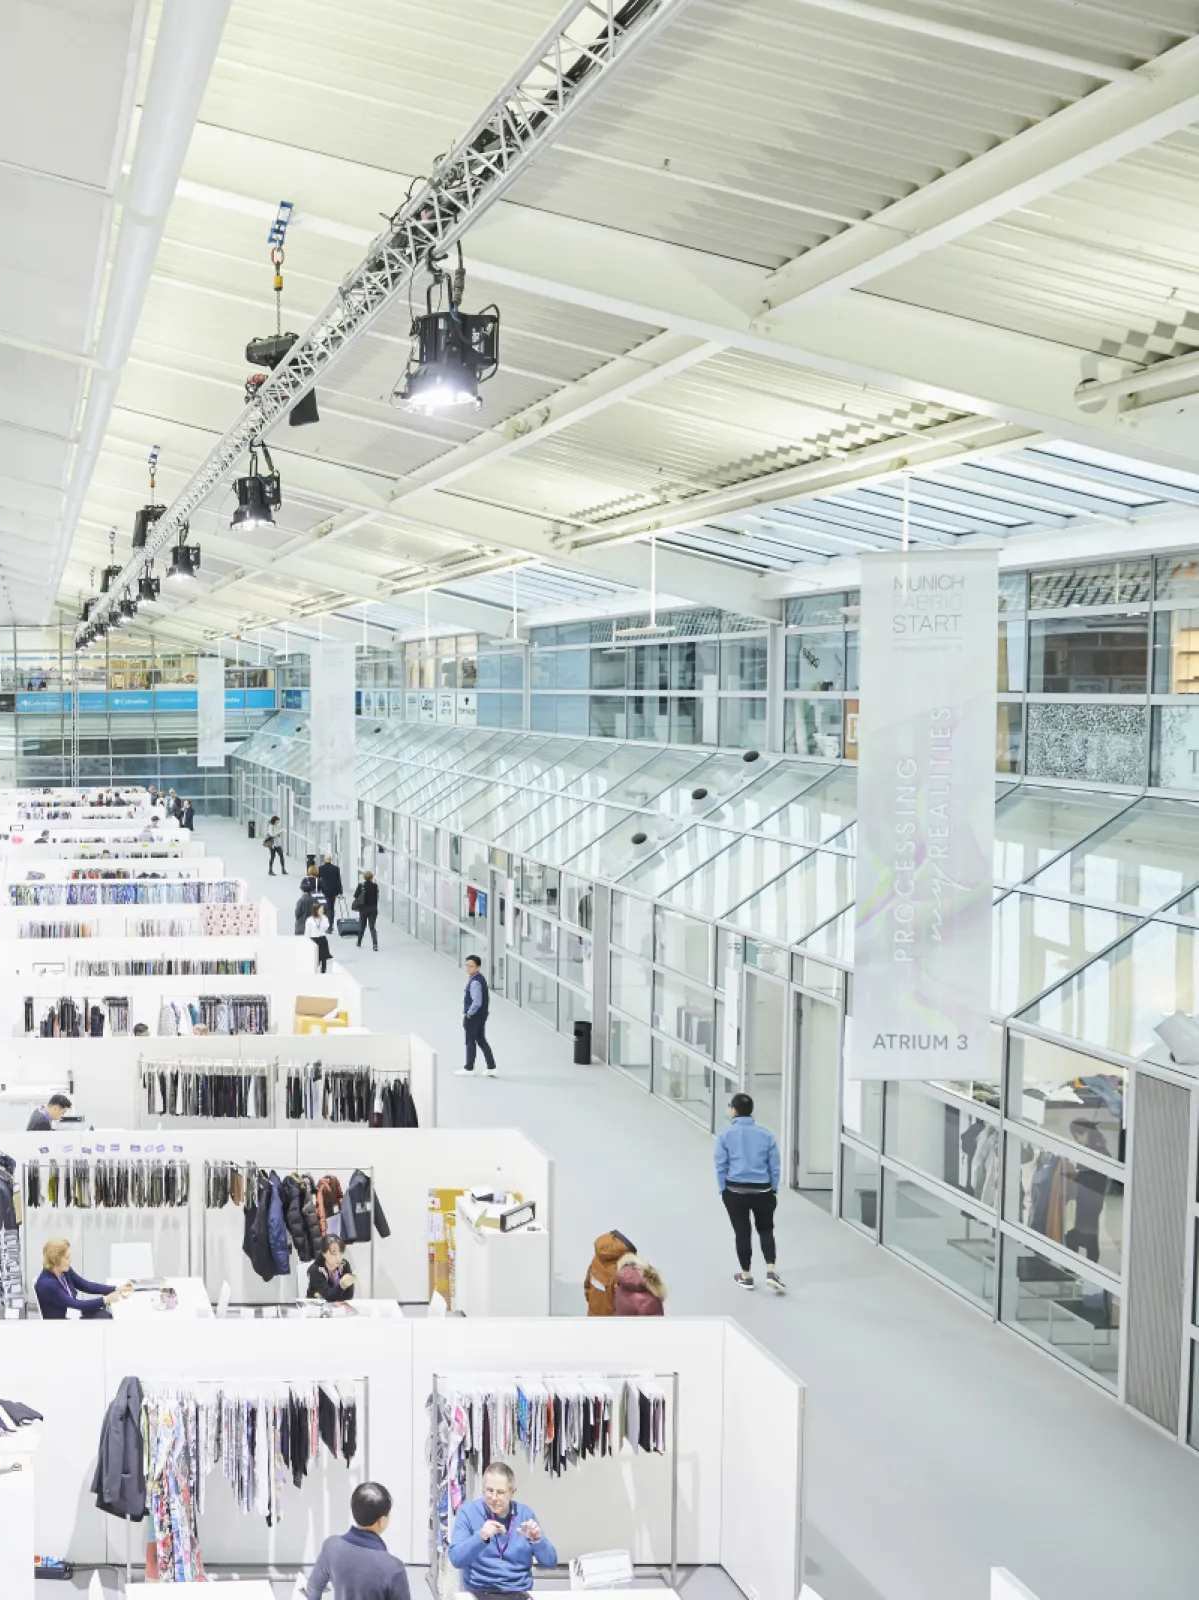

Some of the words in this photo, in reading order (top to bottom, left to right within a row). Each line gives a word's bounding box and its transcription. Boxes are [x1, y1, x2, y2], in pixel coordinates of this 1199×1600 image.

[893, 574, 965, 592] MUNICH
[892, 593, 963, 611] FABRIC
[892, 614, 963, 634] START
[928, 705, 952, 860] REALITIES
[893, 756, 918, 964] PROCESSING
[929, 861, 972, 943] my
[872, 1033, 948, 1051] ATRIUM
[956, 1033, 969, 1051] 3
